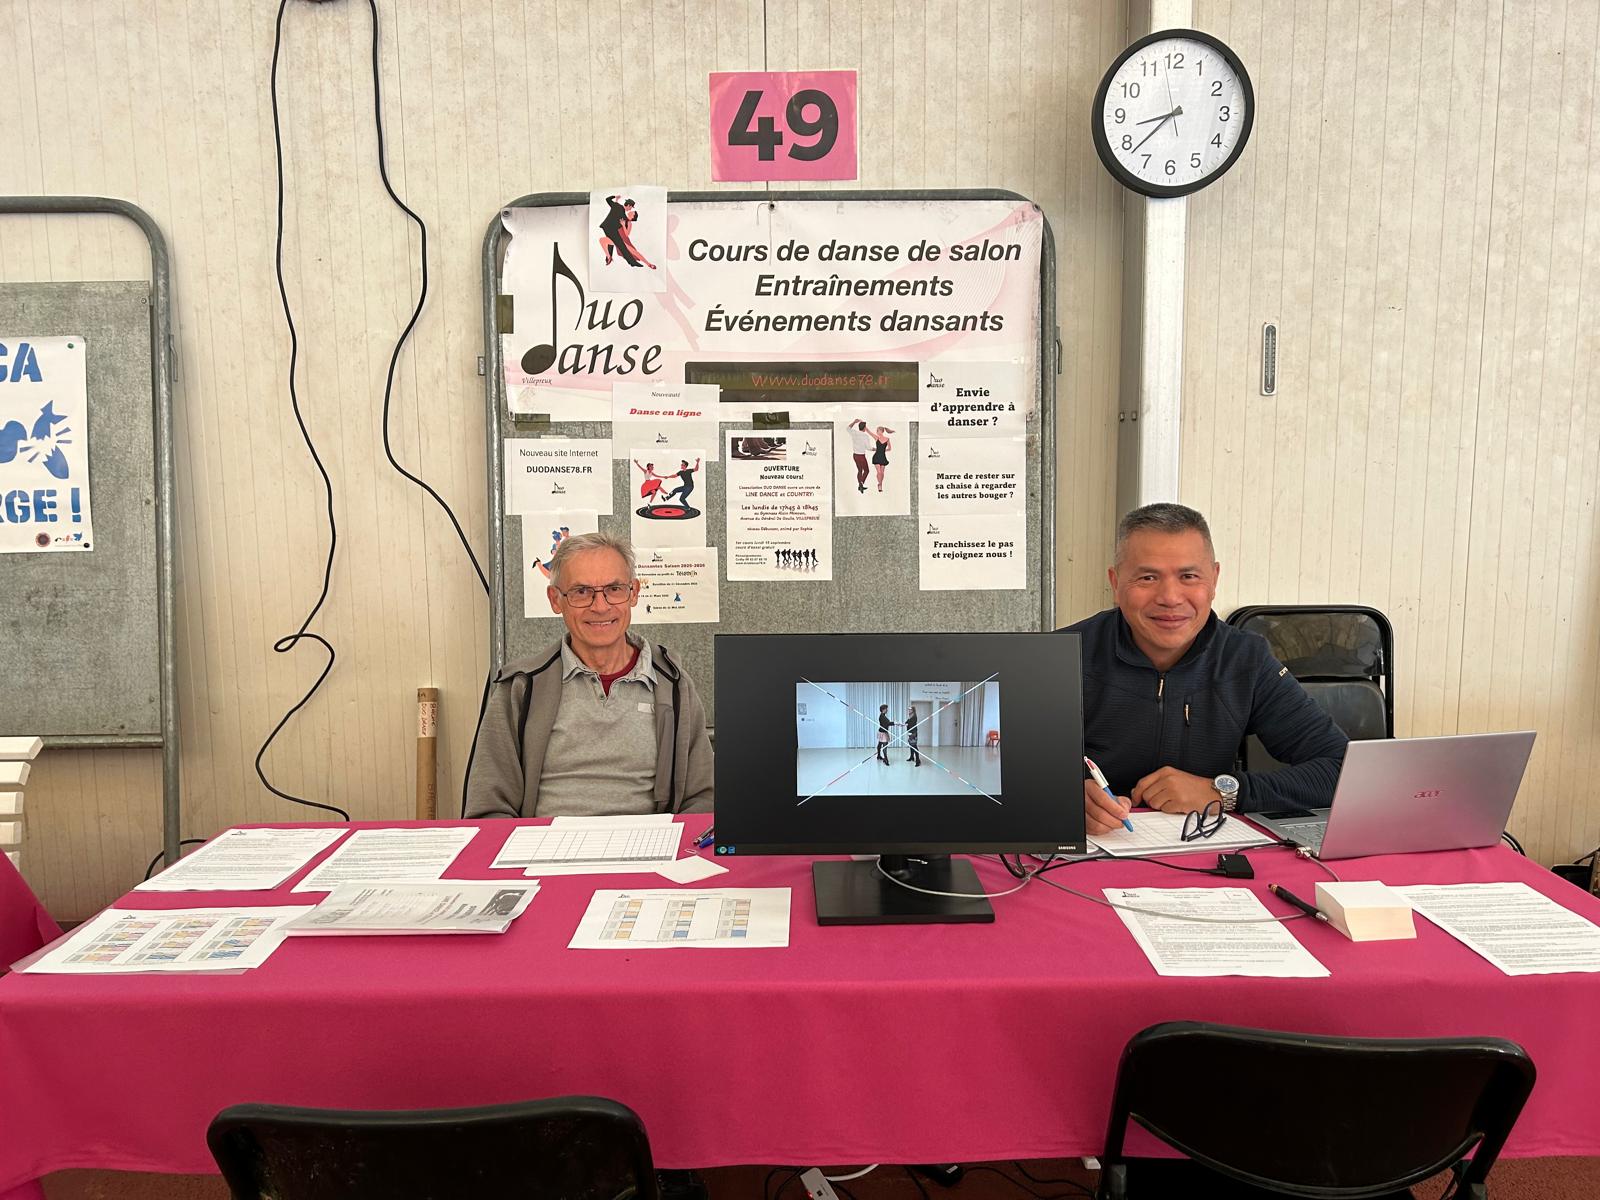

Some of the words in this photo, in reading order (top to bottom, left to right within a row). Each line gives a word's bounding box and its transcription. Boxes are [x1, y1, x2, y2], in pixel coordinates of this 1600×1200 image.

[1140, 61, 1157, 76] 11
[1165, 53, 1184, 69] 12
[1196, 60, 1203, 76] 1
[1120, 82, 1140, 98] 10
[1211, 80, 1223, 97] 2
[1114, 108, 1126, 124] 9
[1219, 105, 1230, 122] 3
[728, 89, 839, 161] 49
[1122, 134, 1132, 151] 8
[1210, 133, 1222, 148] 4
[1141, 154, 1152, 169] 7
[1164, 160, 1176, 175] 6
[1190, 153, 1201, 168] 5
[688, 239, 768, 262] Cours
[776, 239, 810, 262] de
[817, 239, 900, 262] danse
[907, 239, 941, 262] de
[948, 239, 1022, 261] salon
[755, 273, 954, 297] Entraînements
[704, 304, 871, 332] Événements
[880, 309, 1004, 332] dansants
[521, 377, 552, 386] Villepreux
[956, 387, 990, 397] Envie
[629, 408, 660, 416] Danse
[676, 409, 702, 418] ligne
[930, 402, 1005, 414] d'apprendre
[1008, 402, 1016, 411] à
[947, 416, 989, 427] danser
[992, 416, 998, 426] ?
[519, 449, 553, 457] Nouveau
[554, 449, 568, 457] site
[569, 449, 599, 457] Internet
[526, 466, 593, 474] DUODANSE78.FR
[963, 472, 973, 480] de
[946, 482, 972, 490] chaise
[981, 482, 1017, 491] regarder
[979, 492, 1008, 500] bouger
[1009, 491, 1014, 499] ?
[988, 540, 996, 548] le
[998, 541, 1014, 549] pas
[932, 551, 941, 559] et
[943, 551, 984, 560] rejoignez
[1009, 550, 1013, 558] !
